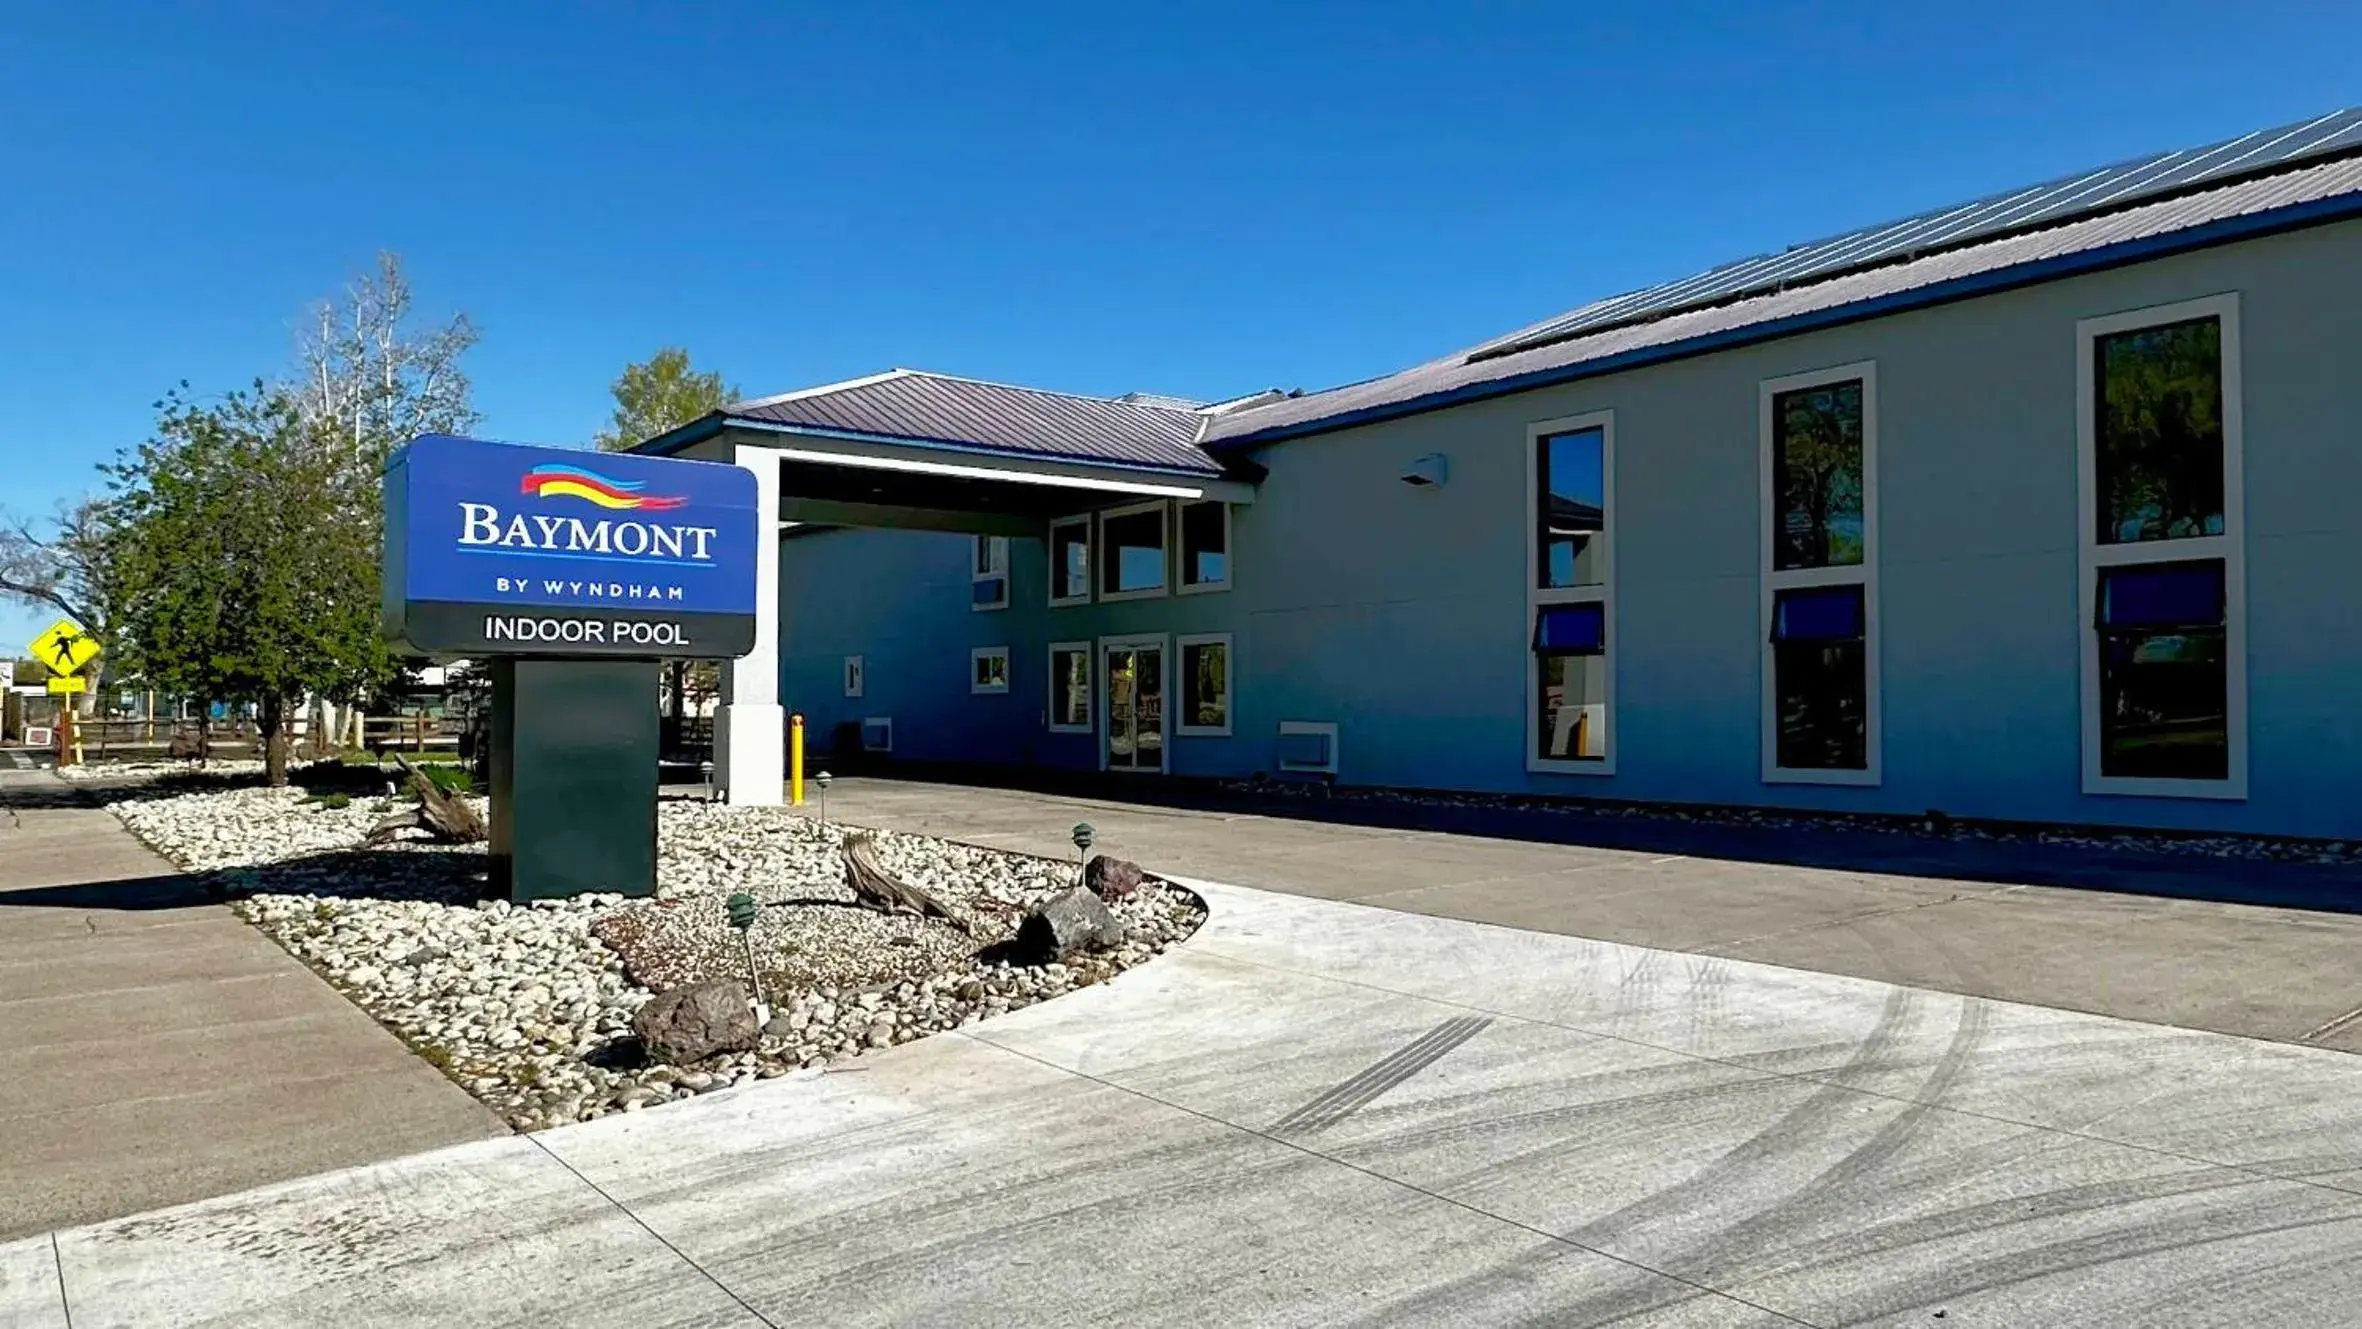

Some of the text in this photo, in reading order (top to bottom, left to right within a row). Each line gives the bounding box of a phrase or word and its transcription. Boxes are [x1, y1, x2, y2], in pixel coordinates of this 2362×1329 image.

[457, 502, 717, 559] BAYMONT
[496, 577, 683, 600] BY WYNDHAM
[485, 616, 690, 645] INDOOR POOL
